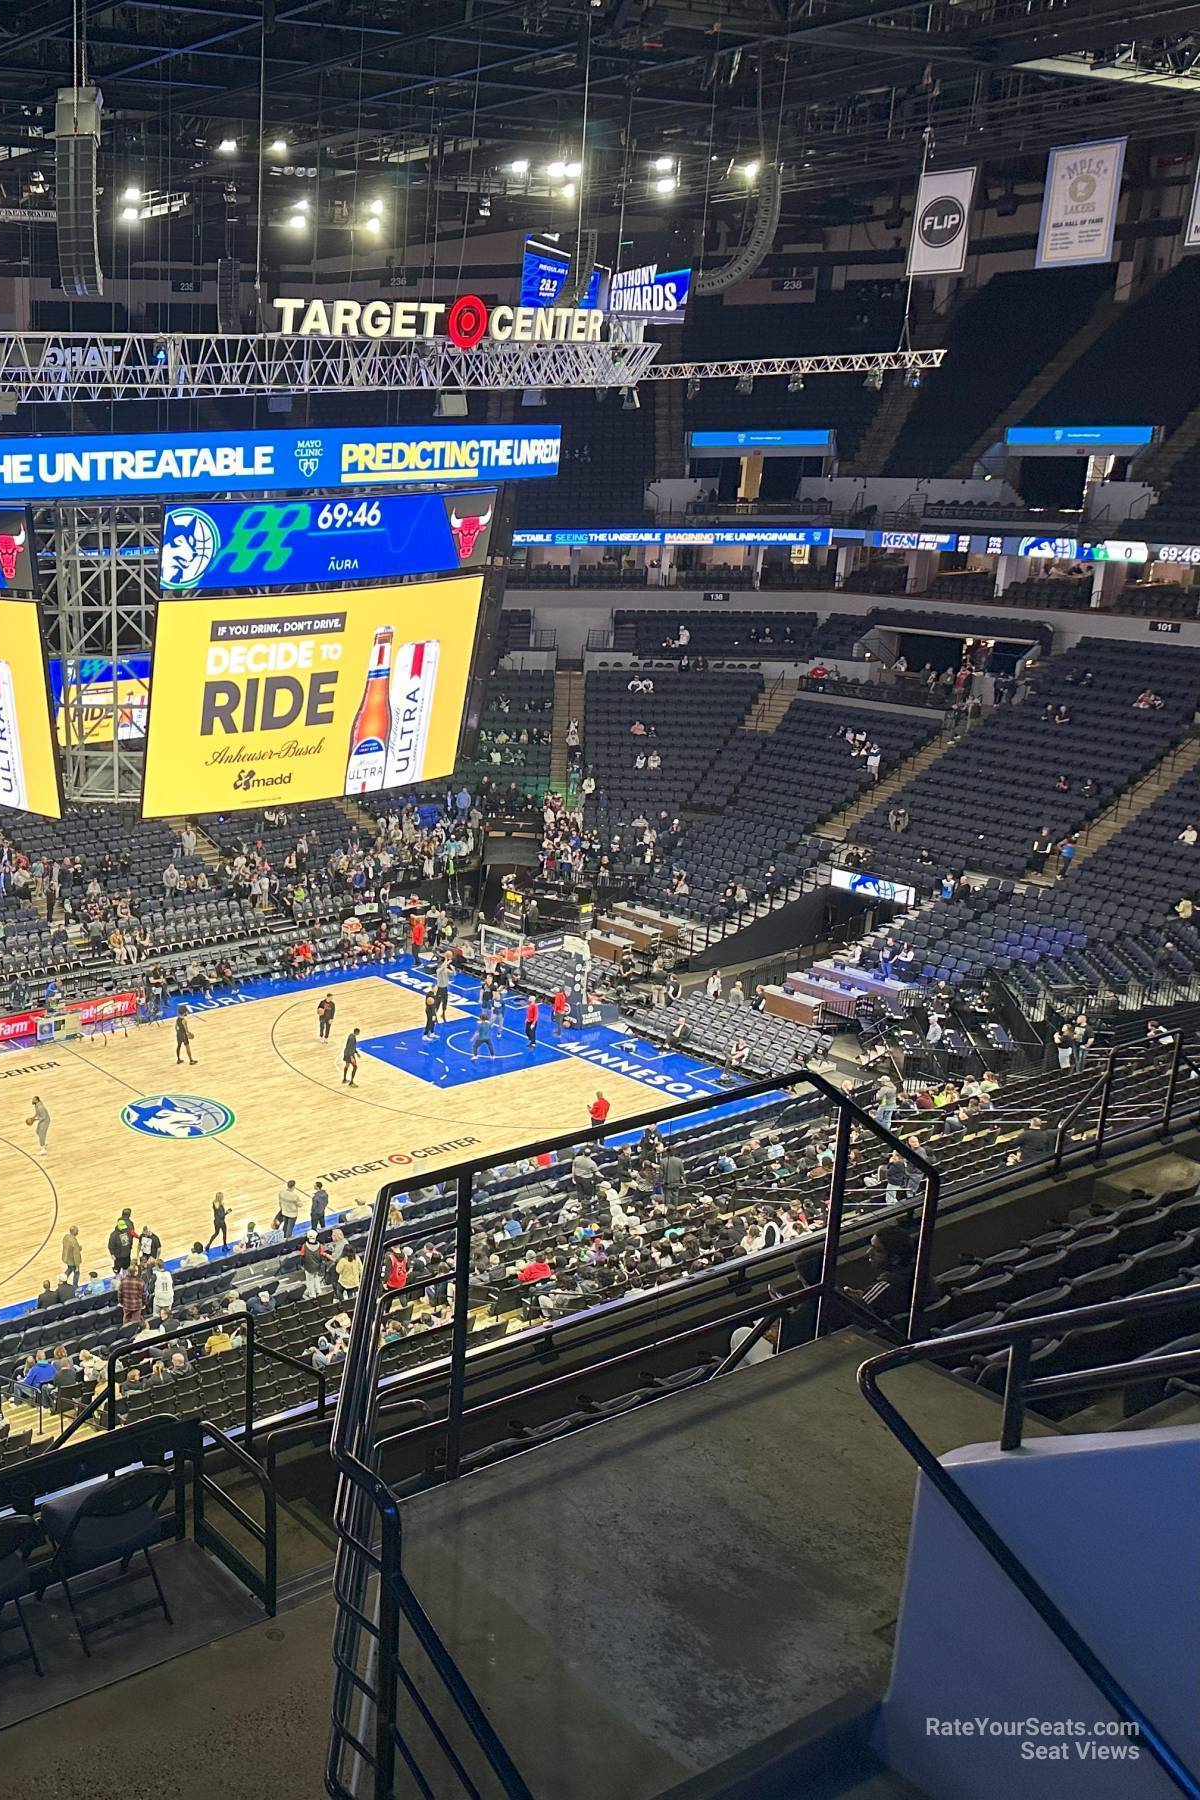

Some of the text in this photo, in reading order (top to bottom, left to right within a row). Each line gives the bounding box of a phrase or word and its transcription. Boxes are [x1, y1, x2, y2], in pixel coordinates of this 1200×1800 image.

[923, 214, 960, 231] FLIP
[612, 264, 658, 291] ANTHONY
[610, 282, 678, 312] EDWARDS
[273, 298, 446, 338] TARGET
[489, 305, 604, 342] CENTER
[294, 447, 324, 457] CLINIC
[297, 440, 322, 448] MAYO
[39, 445, 275, 484] UNTREATABLE
[341, 440, 480, 472] PREDICTING
[479, 439, 514, 467] THE
[317, 500, 382, 530] 69:46
[555, 533, 588, 542] SEEING
[588, 533, 607, 541] THE
[607, 532, 661, 542] UNSEEABLE
[664, 532, 714, 542] IMAGINING
[714, 533, 735, 541] THE
[734, 532, 805, 542] UNIMAGINABLE
[884, 534, 917, 548] KFAN
[217, 618, 342, 636] IF YOU DRINK, DON'T DRIVE.
[1157, 622, 1173, 631] 101
[205, 640, 343, 675] DECIDE TO
[200, 671, 339, 736] RIDE
[395, 687, 420, 774] ULTRA
[204, 736, 324, 766] Anheuser-Busch
[251, 773, 292, 788] madd
[348, 766, 383, 780] ULTRA
[557, 1041, 713, 1100] MINNESOT
[317, 1136, 482, 1184] TARGET CENTER
